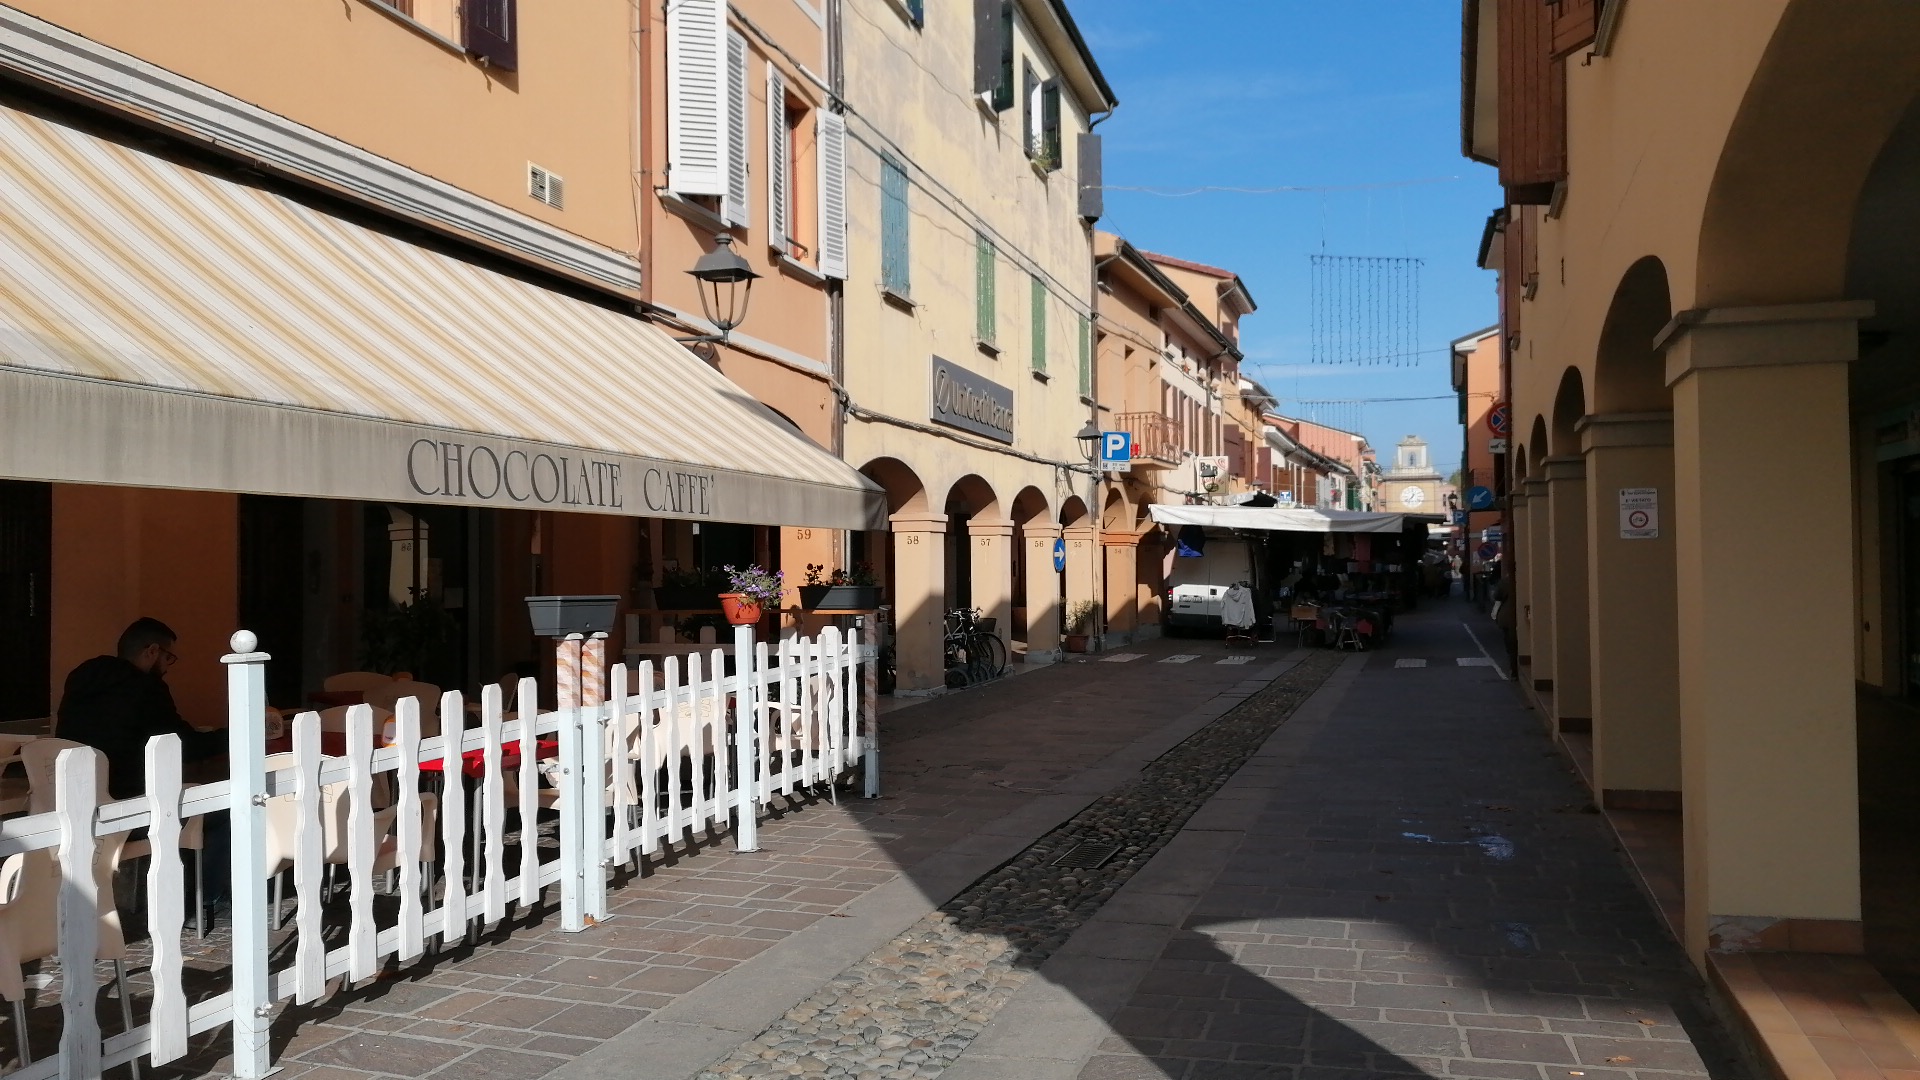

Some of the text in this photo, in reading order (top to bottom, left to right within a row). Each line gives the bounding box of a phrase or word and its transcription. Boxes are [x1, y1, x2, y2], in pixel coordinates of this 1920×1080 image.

[1106, 433, 1125, 458] P
[407, 438, 715, 515] CHOCOLATE CAFFE'
[797, 529, 812, 540] 59
[906, 536, 920, 545] 58
[980, 538, 991, 547] 57
[1034, 540, 1044, 548] 56
